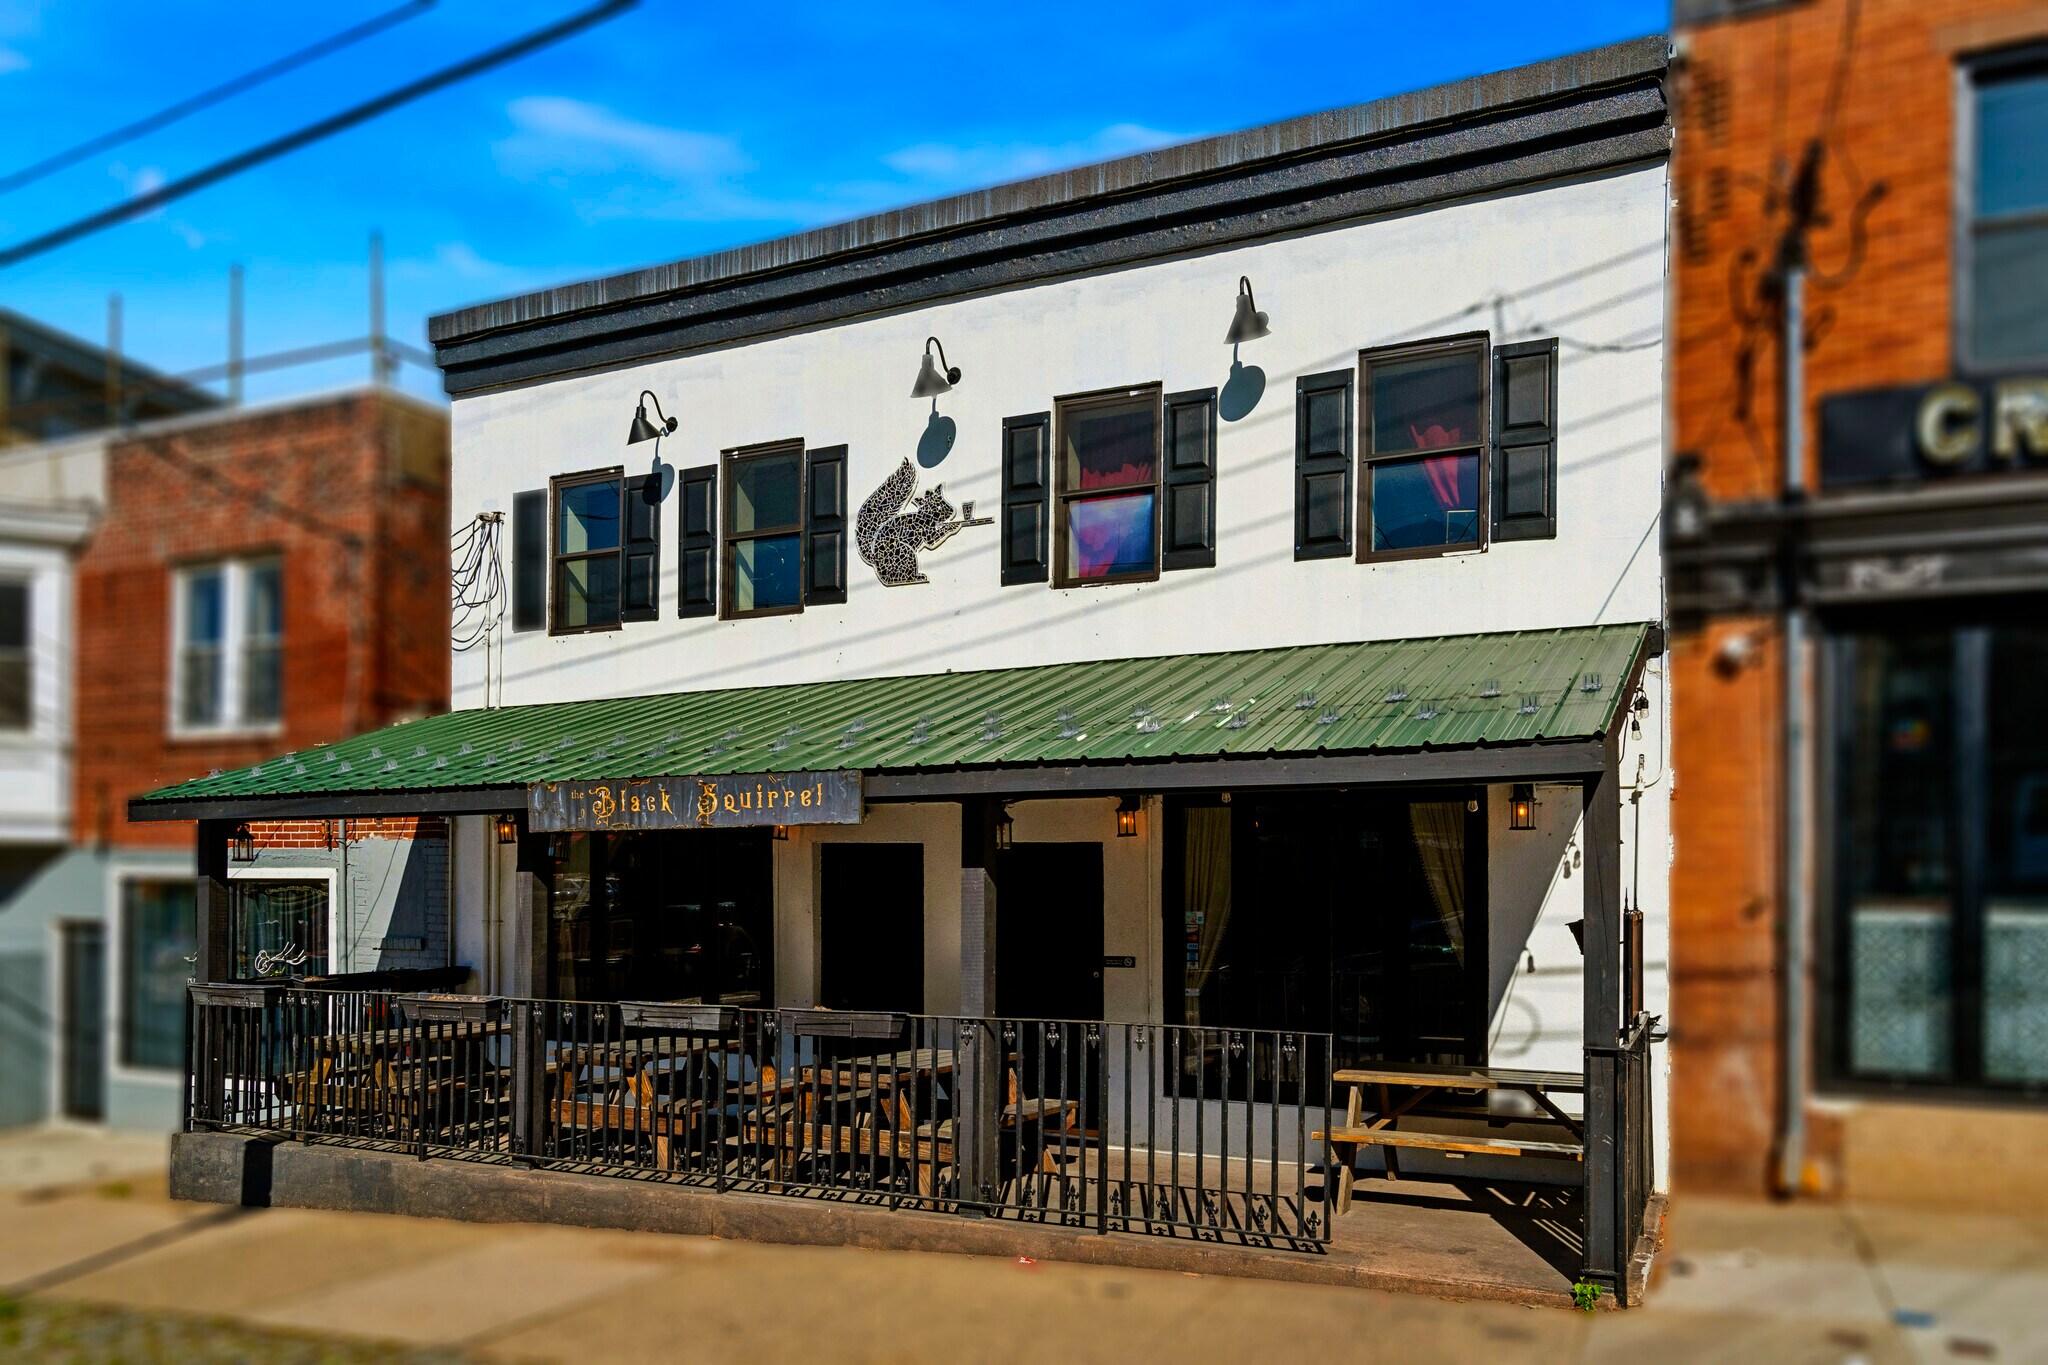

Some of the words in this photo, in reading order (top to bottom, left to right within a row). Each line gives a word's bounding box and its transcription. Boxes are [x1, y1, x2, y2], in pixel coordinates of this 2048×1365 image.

[571, 789, 585, 800] the
[588, 786, 675, 826] Black
[696, 780, 823, 825] Squirrel
